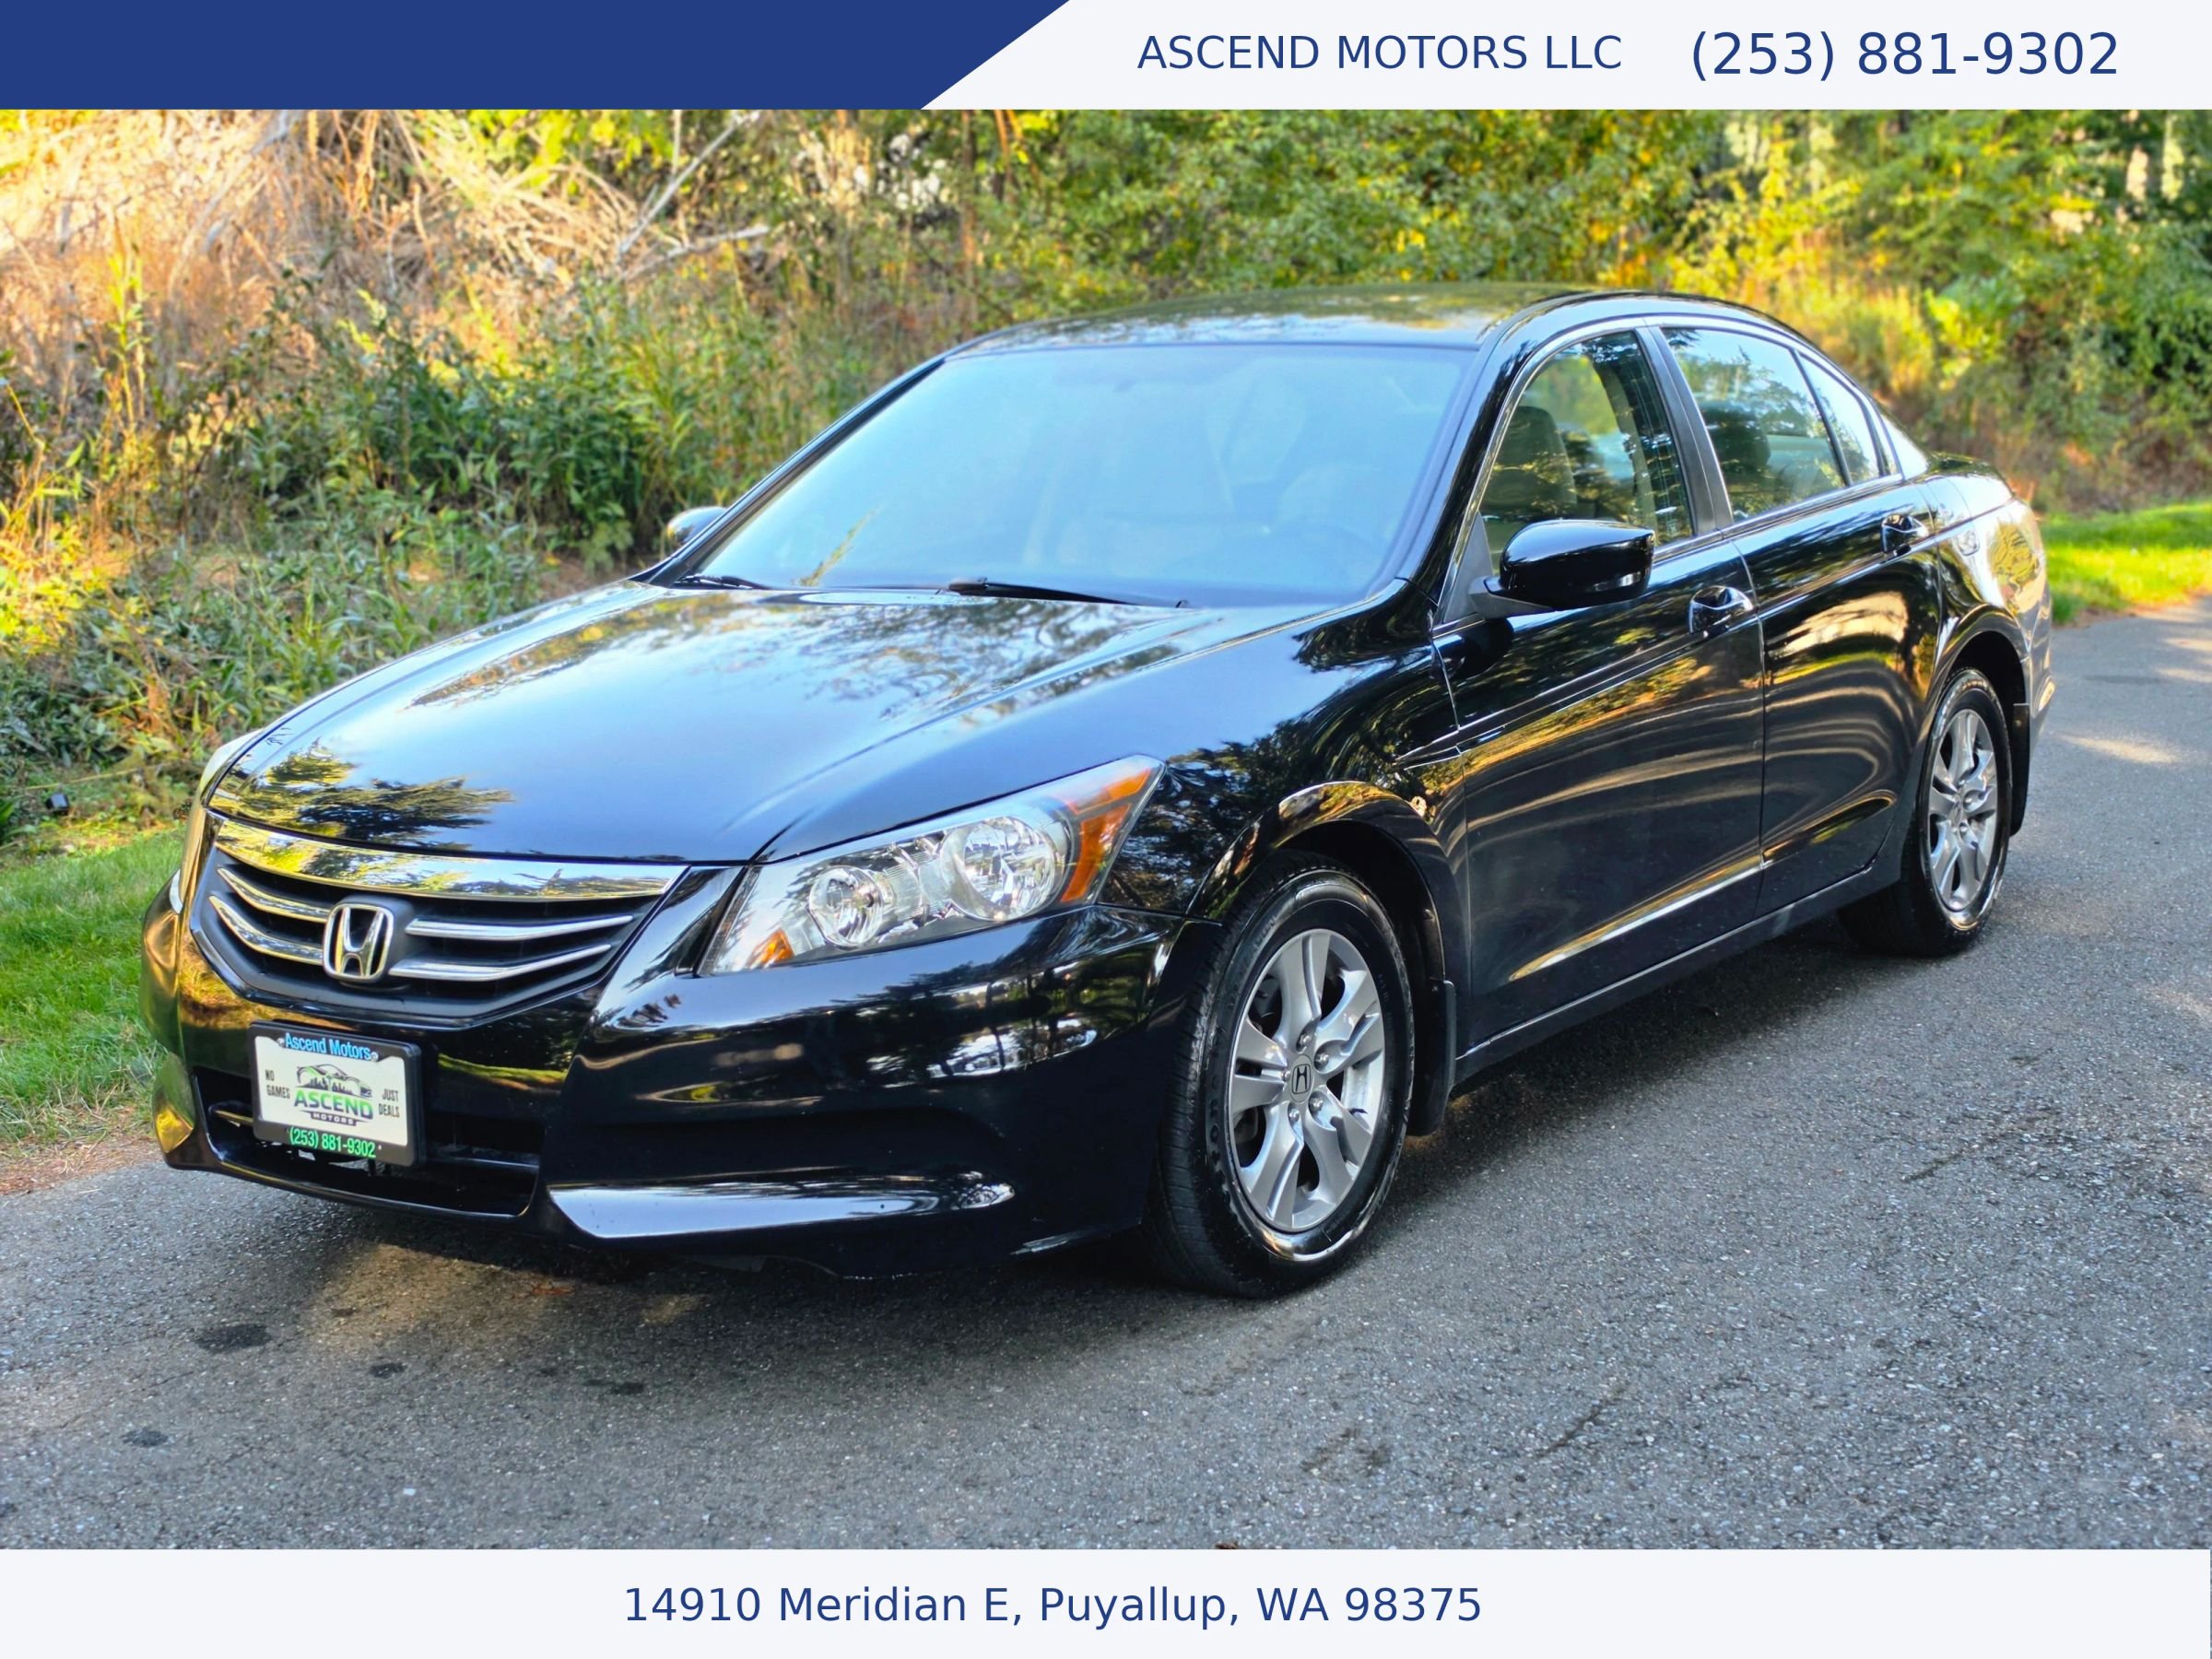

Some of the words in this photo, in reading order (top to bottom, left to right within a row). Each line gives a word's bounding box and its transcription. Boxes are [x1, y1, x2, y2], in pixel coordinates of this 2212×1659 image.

[285, 1032, 326, 1055] Ascend
[330, 1040, 371, 1061] Motors
[265, 1069, 275, 1082] NO
[266, 1084, 290, 1100] GAMES
[382, 1088, 399, 1102] JUST
[294, 1089, 373, 1120] ASCEND
[378, 1103, 400, 1118] DEALS
[312, 1112, 354, 1124] MOTORS
[289, 1126, 319, 1149] (253)
[322, 1134, 377, 1159] 881-9302
